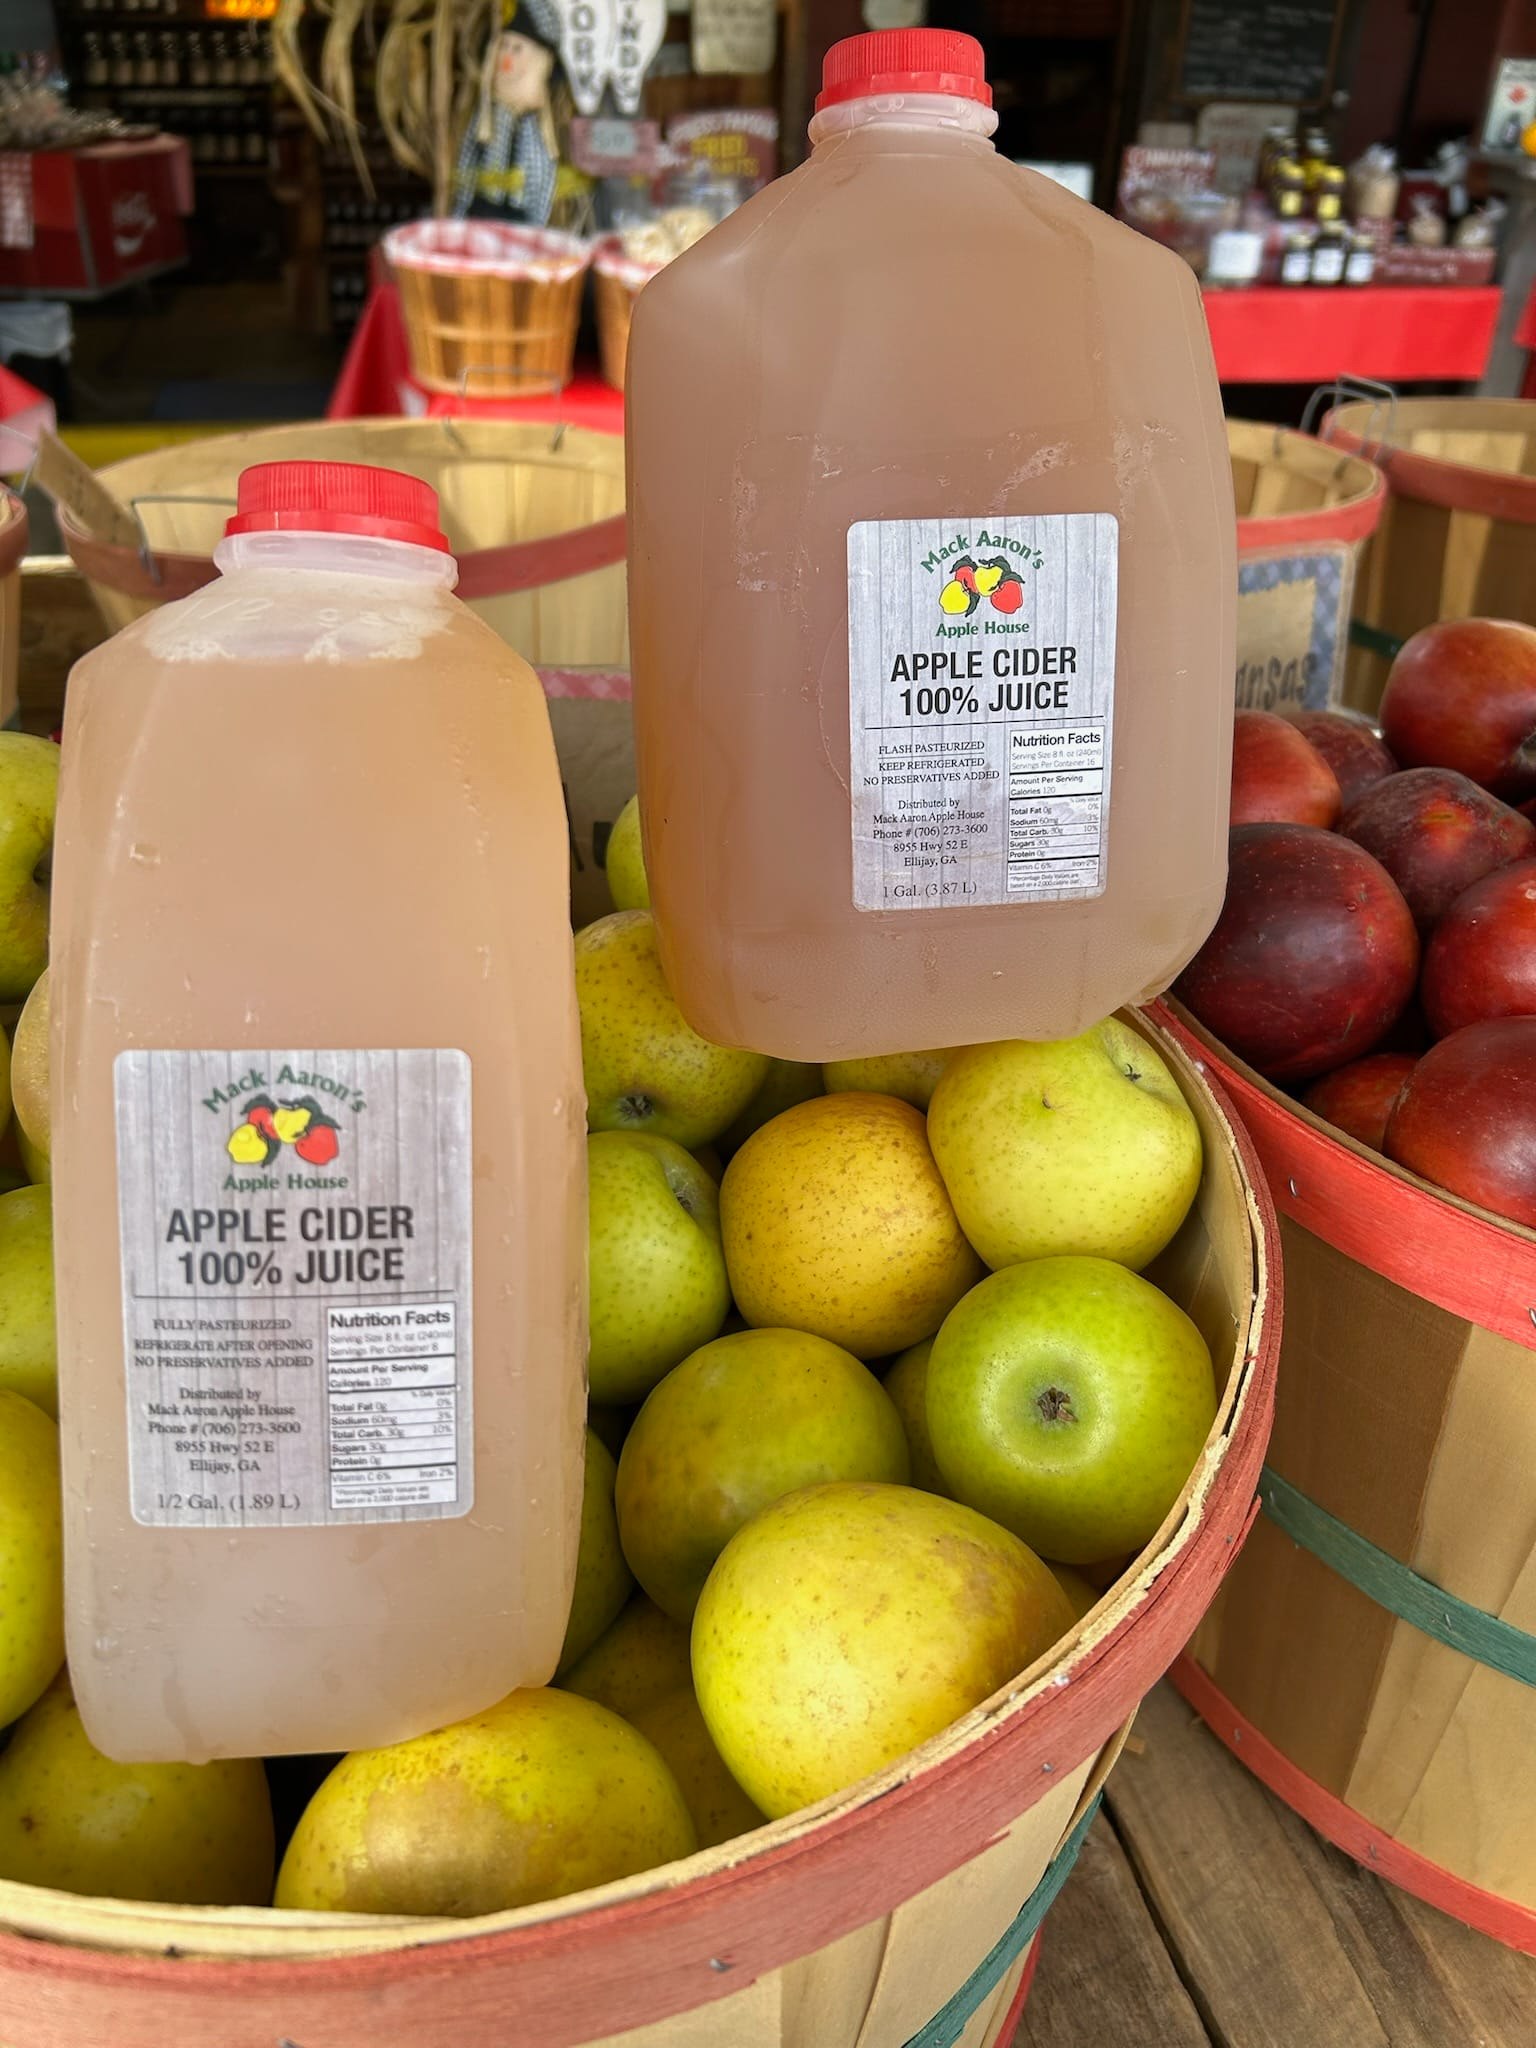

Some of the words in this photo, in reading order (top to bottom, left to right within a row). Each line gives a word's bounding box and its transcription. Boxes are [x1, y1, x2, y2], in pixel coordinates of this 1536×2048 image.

[920, 534, 971, 574] Mack
[976, 530, 1044, 570] Aaron's
[936, 623, 978, 638] Apple
[985, 621, 1030, 634] House
[891, 651, 983, 682] APPLE
[993, 646, 1077, 677] CIDER
[900, 685, 978, 716] 100%
[989, 681, 1068, 711] JUICE
[1013, 734, 1064, 747] Nutrition
[1068, 732, 1101, 744] Facts
[879, 745, 912, 754] FLASH
[915, 741, 985, 753] PASTEURIZED
[879, 762, 905, 771] KEEP
[907, 758, 985, 770] REFRIGERATED
[863, 777, 879, 785] NO
[882, 773, 960, 784] PRESERVATIVES
[963, 771, 1000, 780] ADDED
[899, 800, 946, 809] Distributed
[949, 799, 960, 808] by
[873, 815, 897, 824] Mack
[900, 814, 926, 823] Aaron
[929, 812, 955, 823] Apple
[958, 811, 985, 819] House
[873, 829, 902, 839] Phone
[915, 827, 940, 838] (706)
[943, 824, 988, 835] 273-3600
[894, 843, 917, 852] 8955
[920, 842, 942, 853] Hwy
[946, 841, 957, 849] 52
[961, 840, 968, 848] E
[904, 857, 938, 868] Ellijay,
[941, 856, 957, 864] GA
[884, 887, 888, 897] 1
[894, 885, 921, 897] Gal.
[926, 883, 958, 897] (3.87
[963, 882, 976, 894] L)
[202, 1068, 266, 1114] Mack
[277, 1064, 369, 1113] Aaron's
[223, 1175, 280, 1194] Apple
[288, 1174, 348, 1189] House
[166, 1208, 286, 1243] APPLE
[300, 1205, 415, 1241] CIDER
[178, 1250, 282, 1286] 100%
[295, 1248, 405, 1283] JUICE
[153, 1320, 196, 1330] FULLY
[200, 1319, 291, 1330] PASTEURIZED
[330, 1312, 401, 1328] Nutrition
[405, 1311, 450, 1324] Facts
[134, 1339, 214, 1351] REFRIGERATE
[218, 1340, 254, 1351] AFTER
[258, 1339, 313, 1350] OPENING
[134, 1356, 154, 1366] NO
[158, 1357, 261, 1368] PRESERVATIVES
[265, 1356, 313, 1367] ADDED
[392, 1363, 428, 1372] Serving
[179, 1388, 243, 1398] Distributed
[247, 1388, 261, 1401] by
[148, 1404, 179, 1416] Mack
[182, 1405, 217, 1416] Aaron
[220, 1405, 255, 1418] Apple
[258, 1405, 295, 1416] House
[331, 1403, 354, 1411] Total
[331, 1417, 369, 1425] Sodium
[148, 1422, 186, 1434] Phone
[190, 1423, 198, 1433] #
[202, 1422, 236, 1436] (706)
[240, 1422, 301, 1434] 273-3600
[331, 1430, 355, 1438] Total
[175, 1441, 206, 1452] 8955
[210, 1442, 239, 1455] Hwy
[245, 1441, 260, 1452] 52
[264, 1441, 274, 1452] E
[331, 1444, 366, 1454] Sugars
[190, 1459, 235, 1473] Ellijay,
[239, 1460, 261, 1471] GA
[332, 1457, 367, 1465] Protein
[158, 1493, 182, 1509] 1/2
[188, 1494, 224, 1509] Gal.
[229, 1494, 274, 1511] (1.89
[280, 1494, 301, 1510] L)
